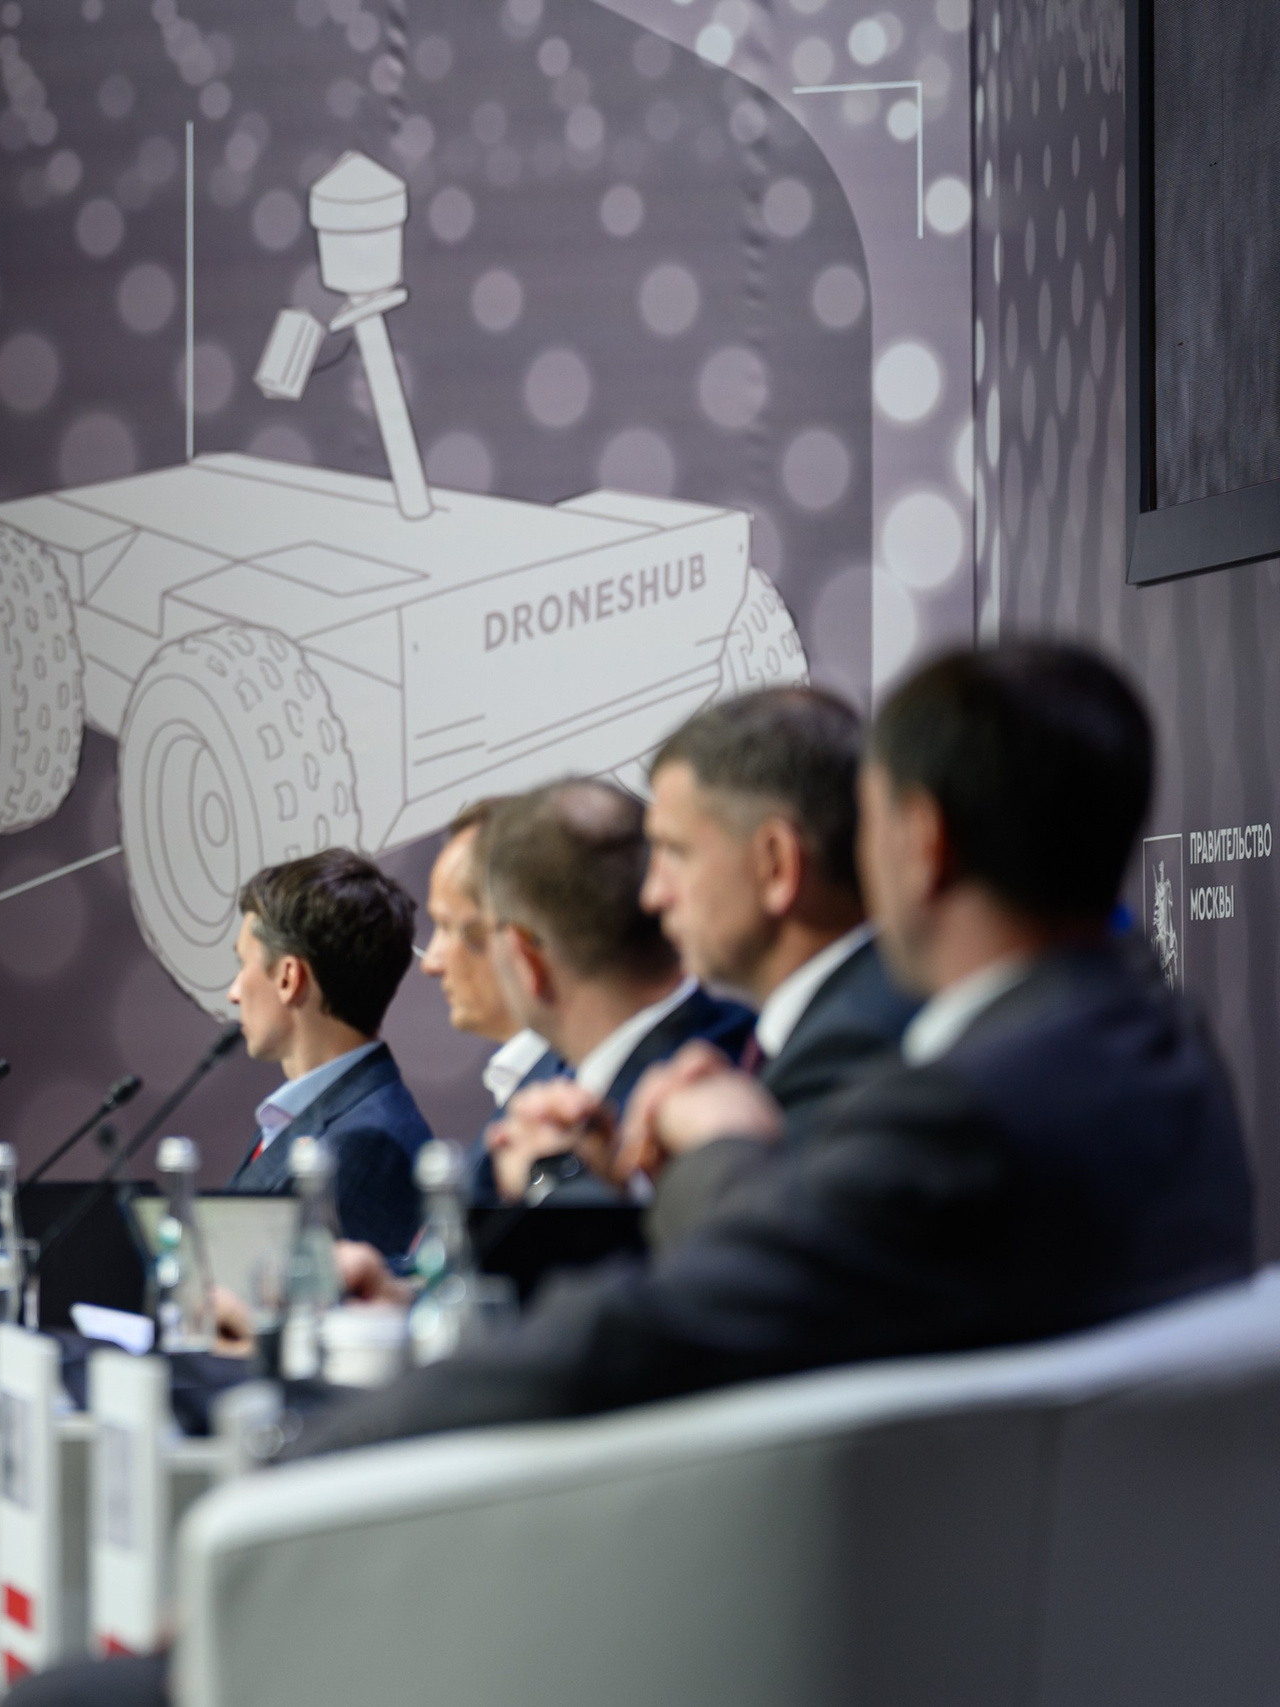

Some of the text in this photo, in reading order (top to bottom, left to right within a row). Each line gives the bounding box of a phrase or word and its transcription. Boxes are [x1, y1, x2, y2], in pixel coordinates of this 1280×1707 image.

[484, 552, 707, 652] DRONESHUB
[1189, 823, 1272, 865] ПРАВИТЕЛЬСТВО
[1190, 885, 1234, 921] МОСКВЫ
